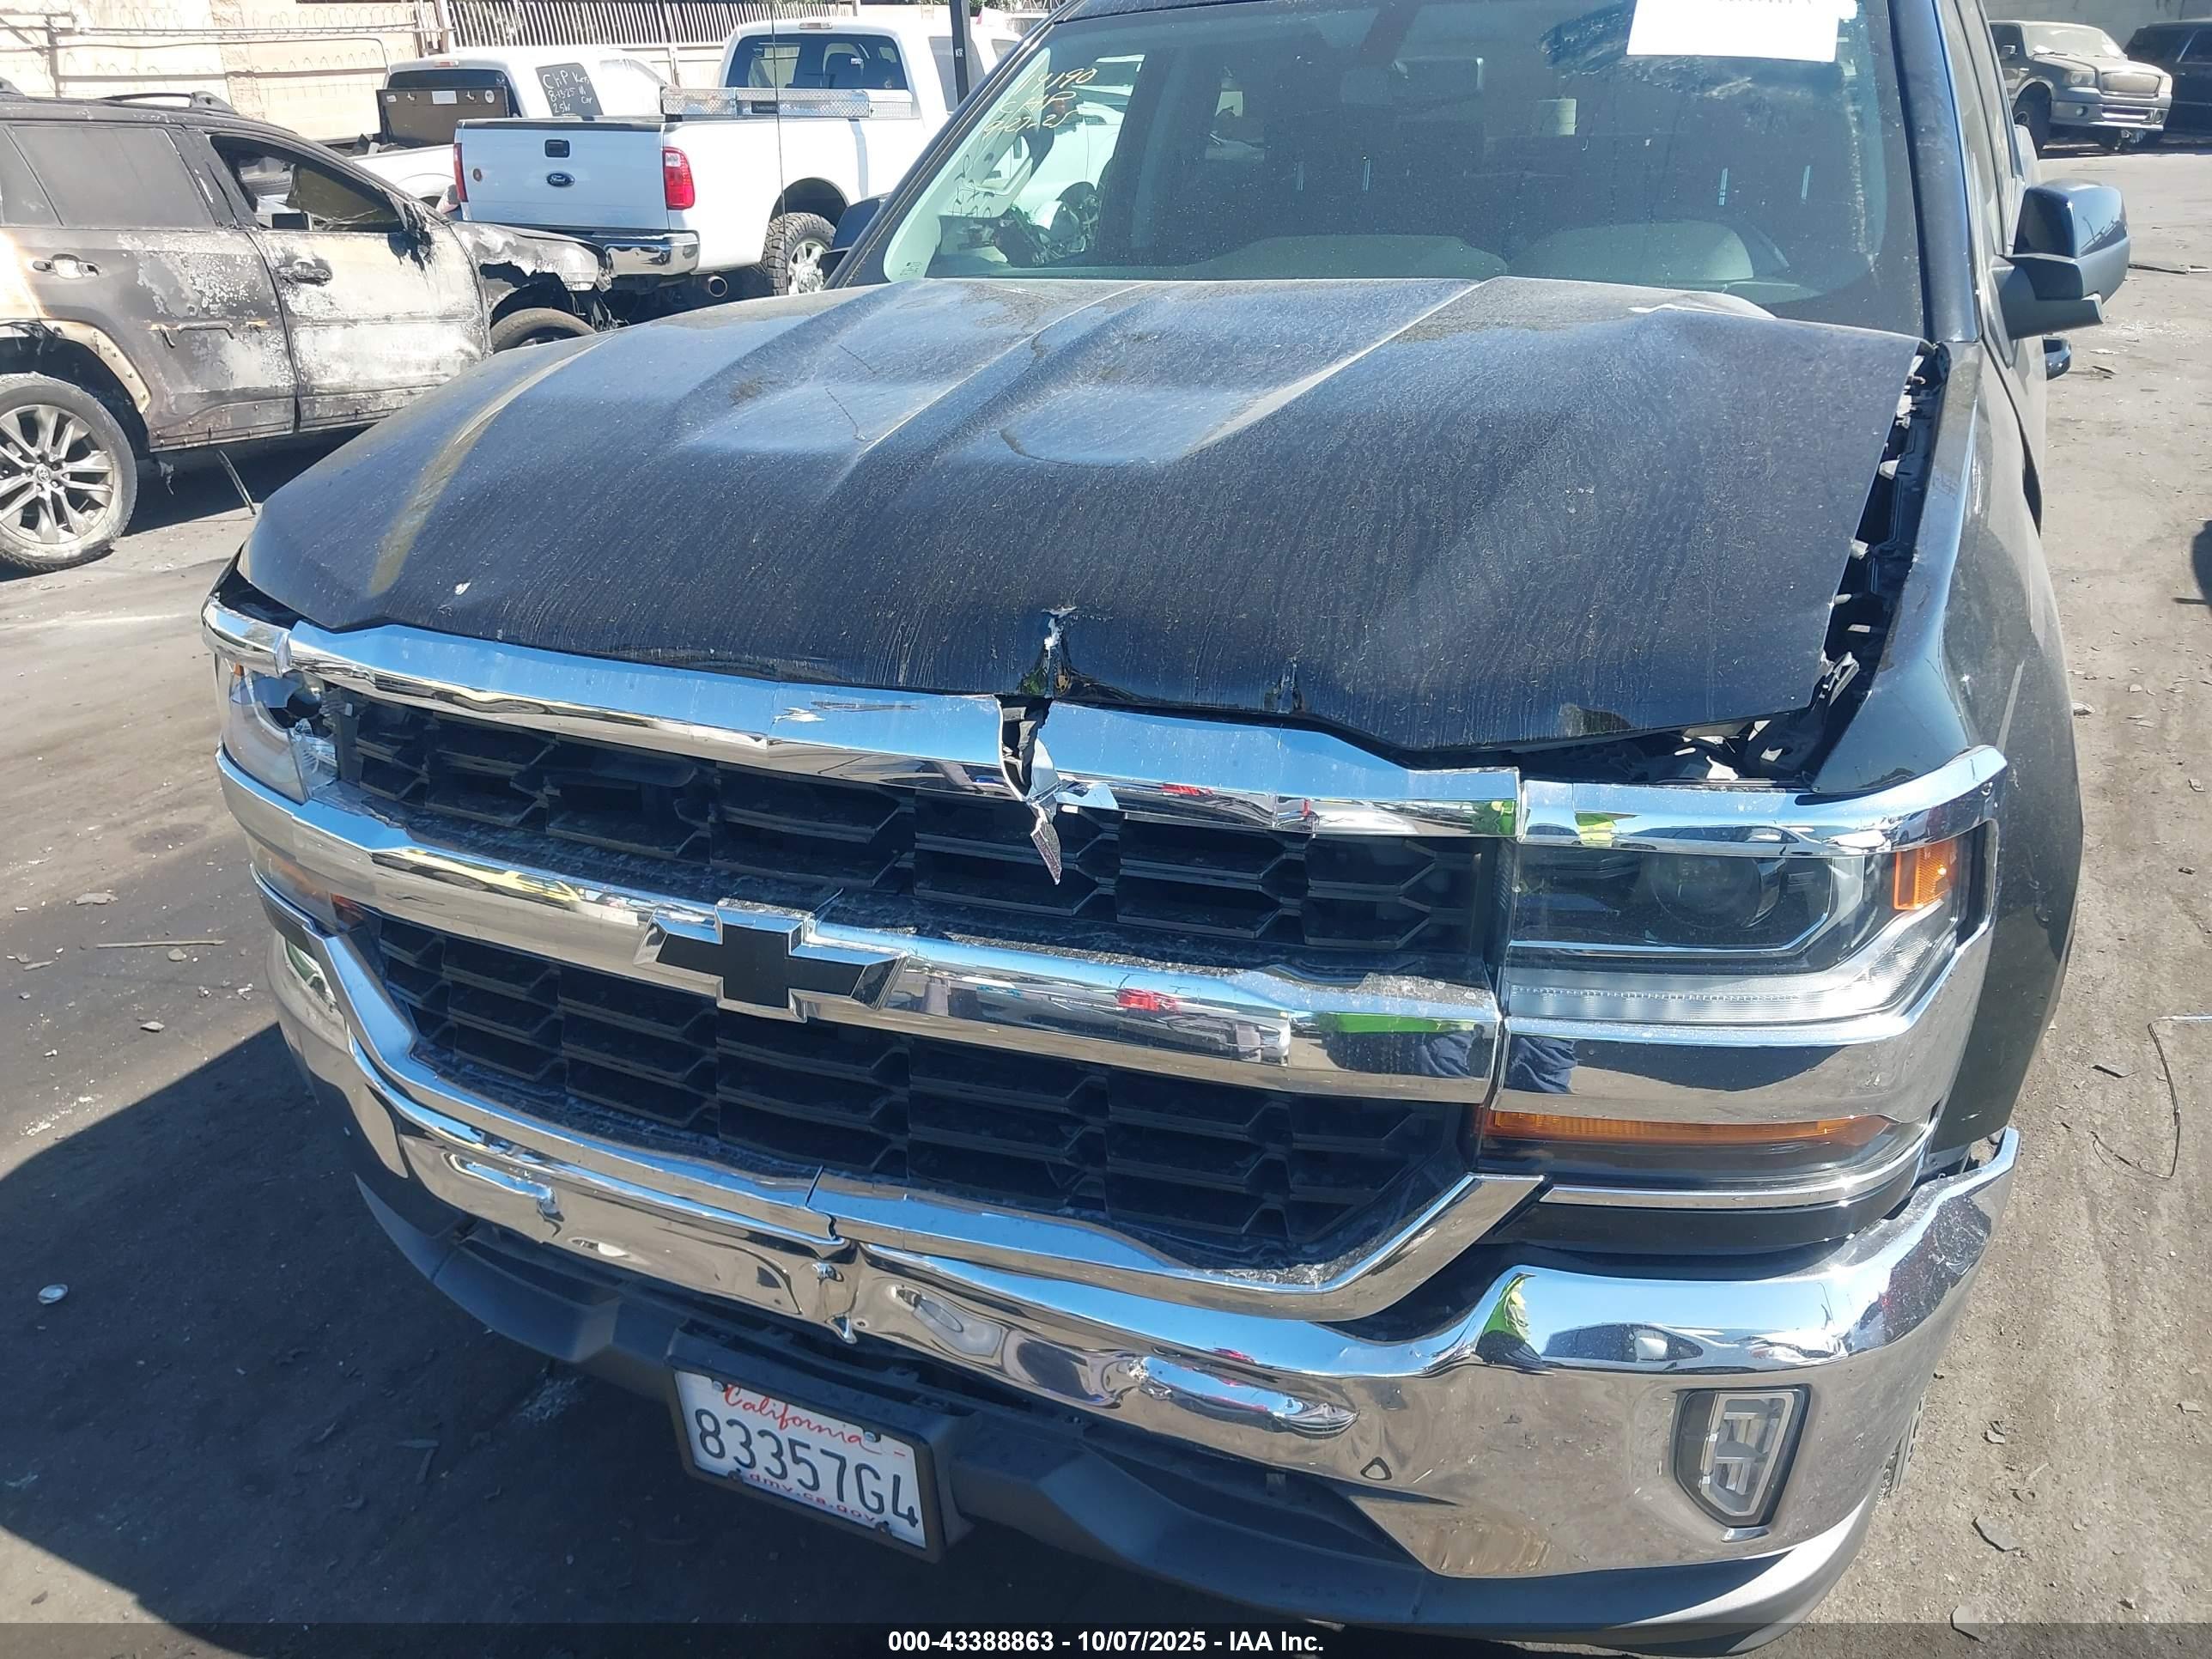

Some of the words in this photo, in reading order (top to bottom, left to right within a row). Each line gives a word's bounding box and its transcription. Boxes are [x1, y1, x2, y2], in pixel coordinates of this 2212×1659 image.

[724, 1383, 882, 1455] California
[694, 1407, 920, 1528] 83357G4
[749, 1471, 877, 1523] dmv.ca.gov
